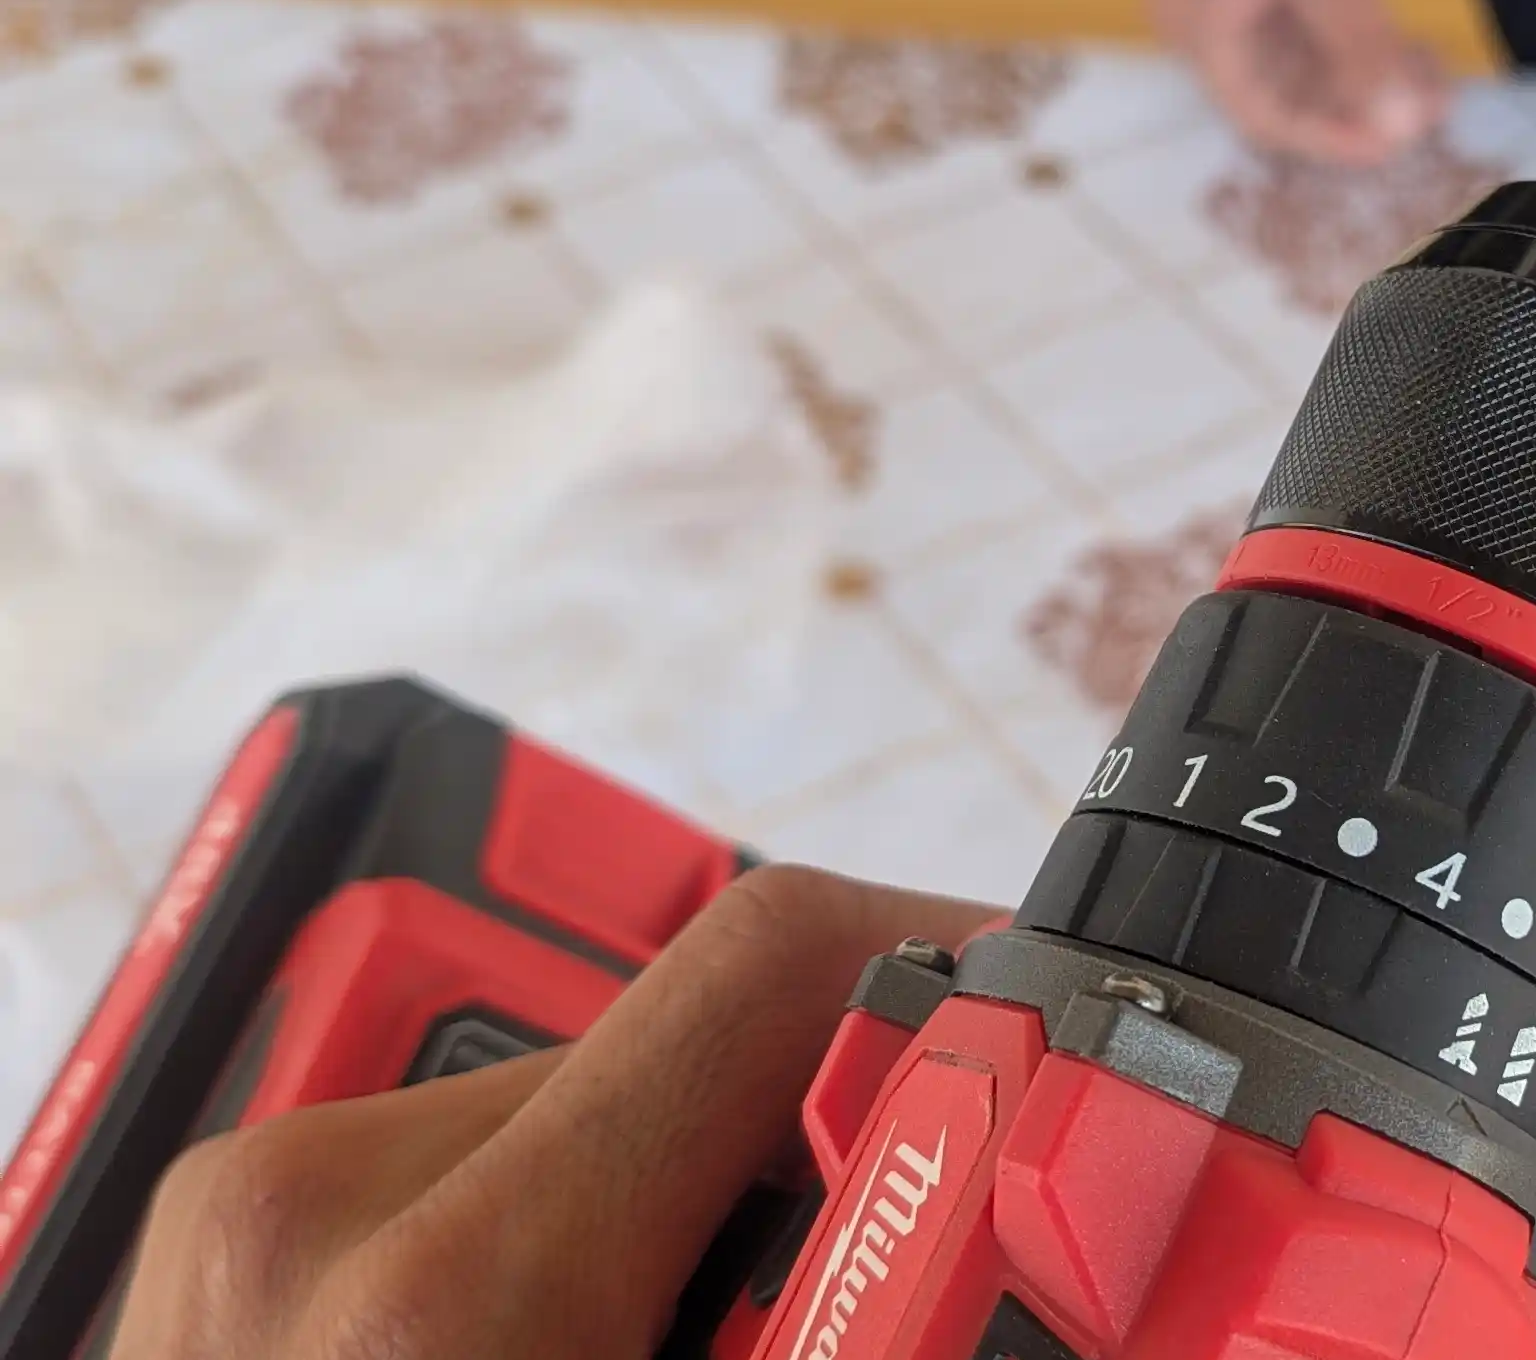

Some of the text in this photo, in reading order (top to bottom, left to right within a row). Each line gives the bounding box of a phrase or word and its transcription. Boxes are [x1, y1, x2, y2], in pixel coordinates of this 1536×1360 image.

[1306, 543, 1388, 585] 13mm
[1083, 746, 1134, 800] 20
[1173, 754, 1209, 808] 1
[1240, 775, 1298, 837] 2
[1414, 851, 1468, 910] 4
